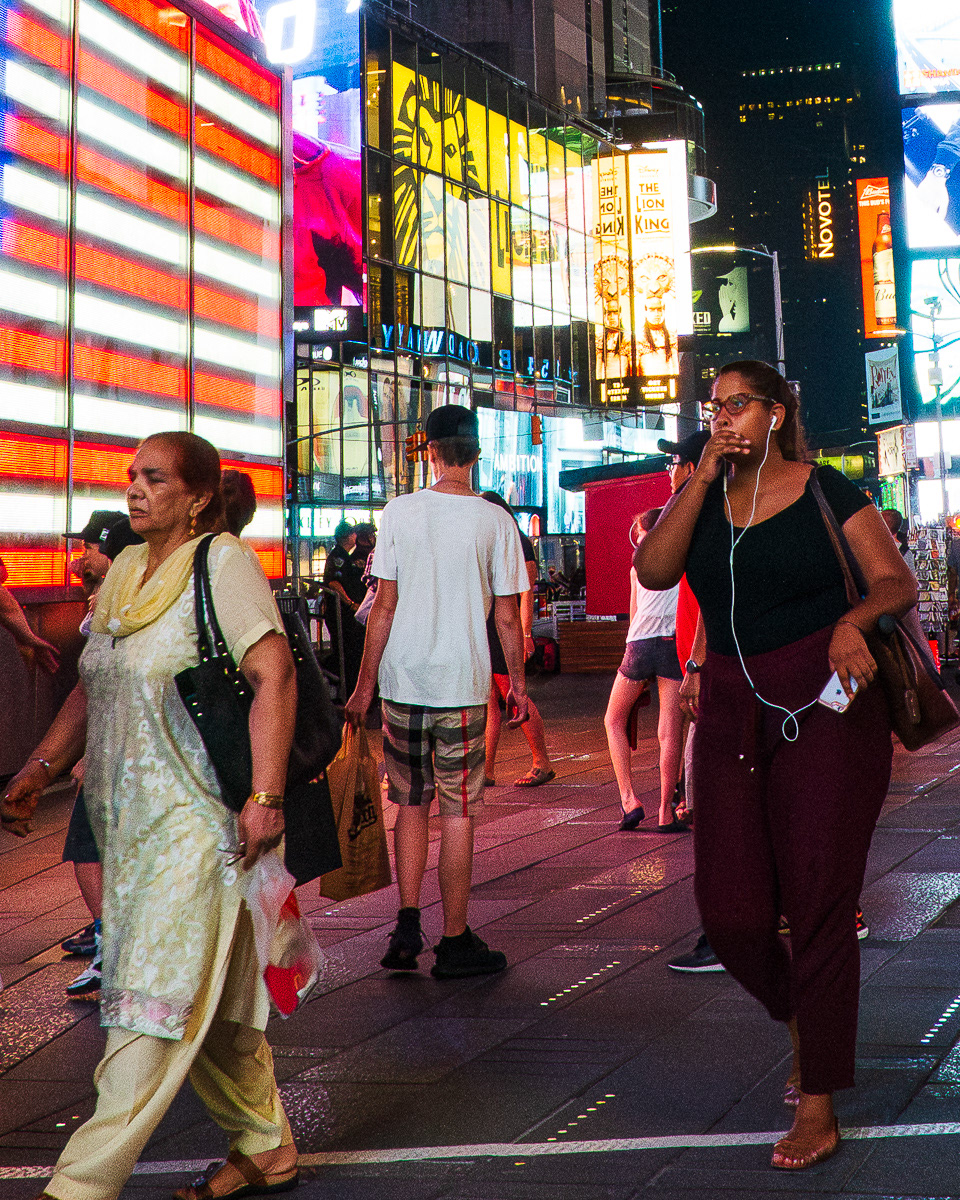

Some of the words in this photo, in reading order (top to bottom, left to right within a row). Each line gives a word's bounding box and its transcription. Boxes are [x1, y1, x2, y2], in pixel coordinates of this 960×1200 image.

[639, 183, 659, 192] THE
[636, 196, 664, 212] LION
[815, 166, 834, 258] NOVOTEL
[635, 215, 669, 234] KING
[314, 309, 347, 331] MTV
